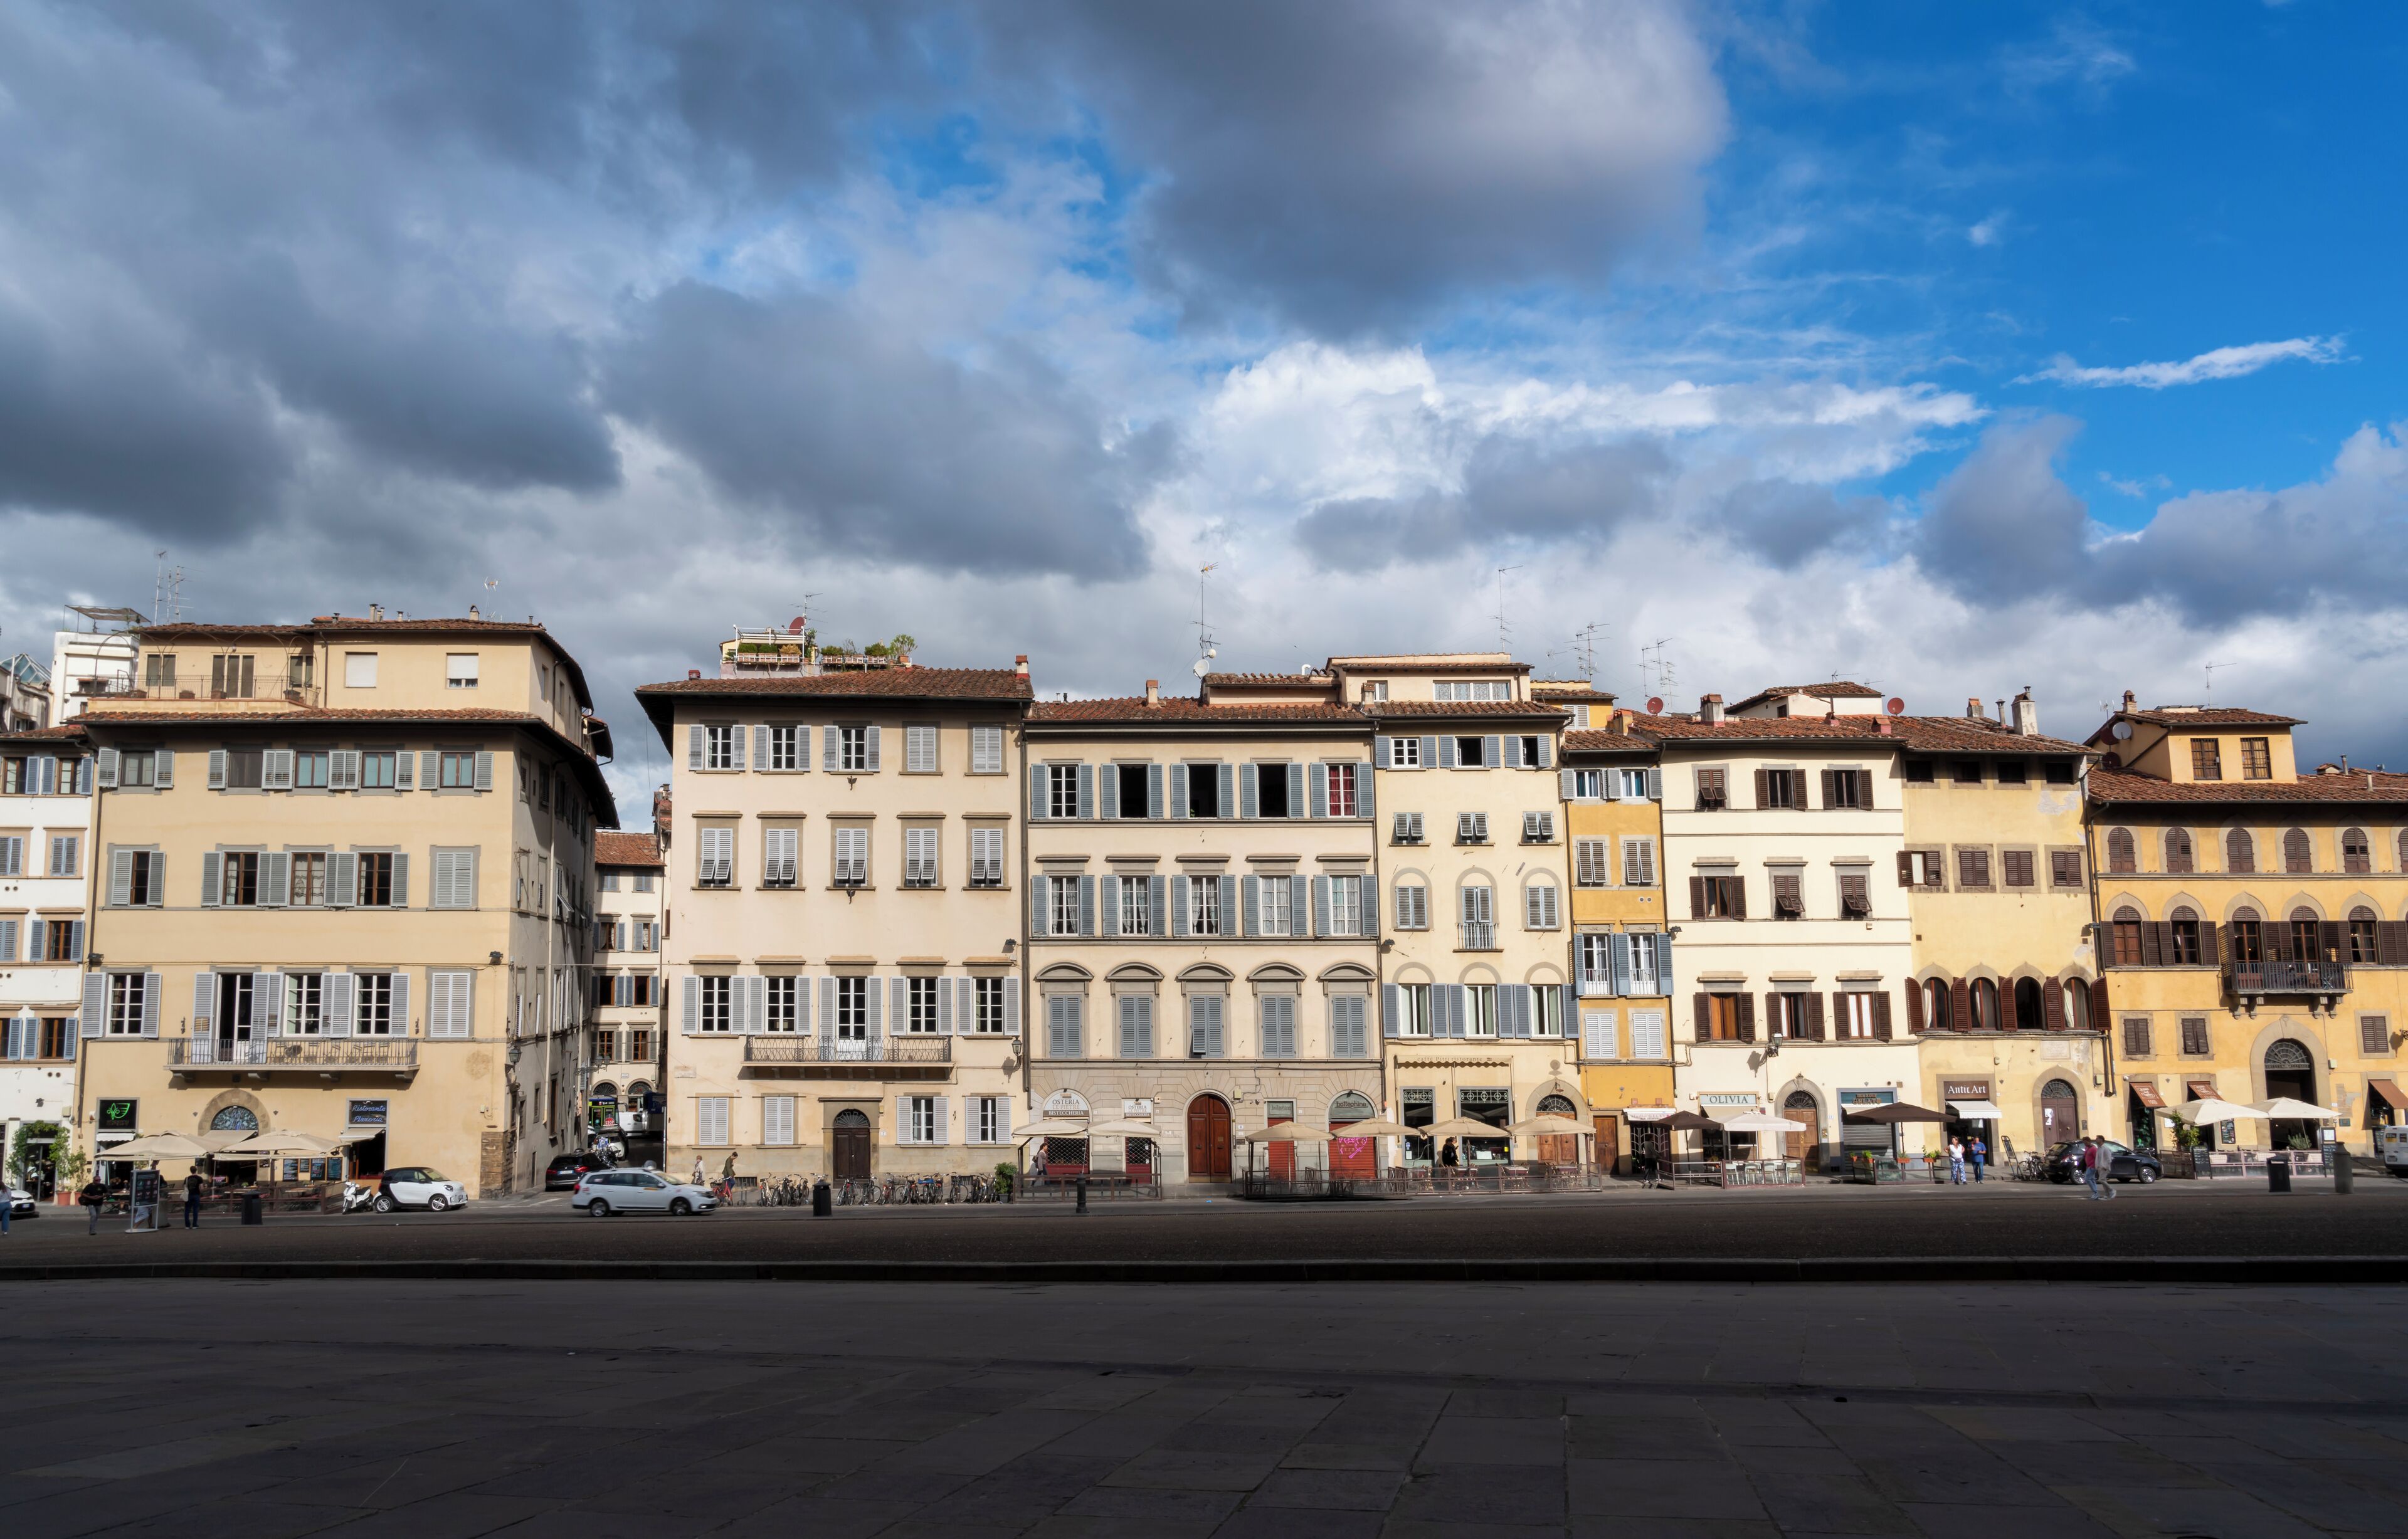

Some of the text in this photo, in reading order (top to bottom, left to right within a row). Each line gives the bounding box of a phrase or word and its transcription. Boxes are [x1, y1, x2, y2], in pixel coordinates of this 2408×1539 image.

[1948, 1085, 1986, 1094] Antic Art
[1709, 1095, 1748, 1103] OLIVIA
